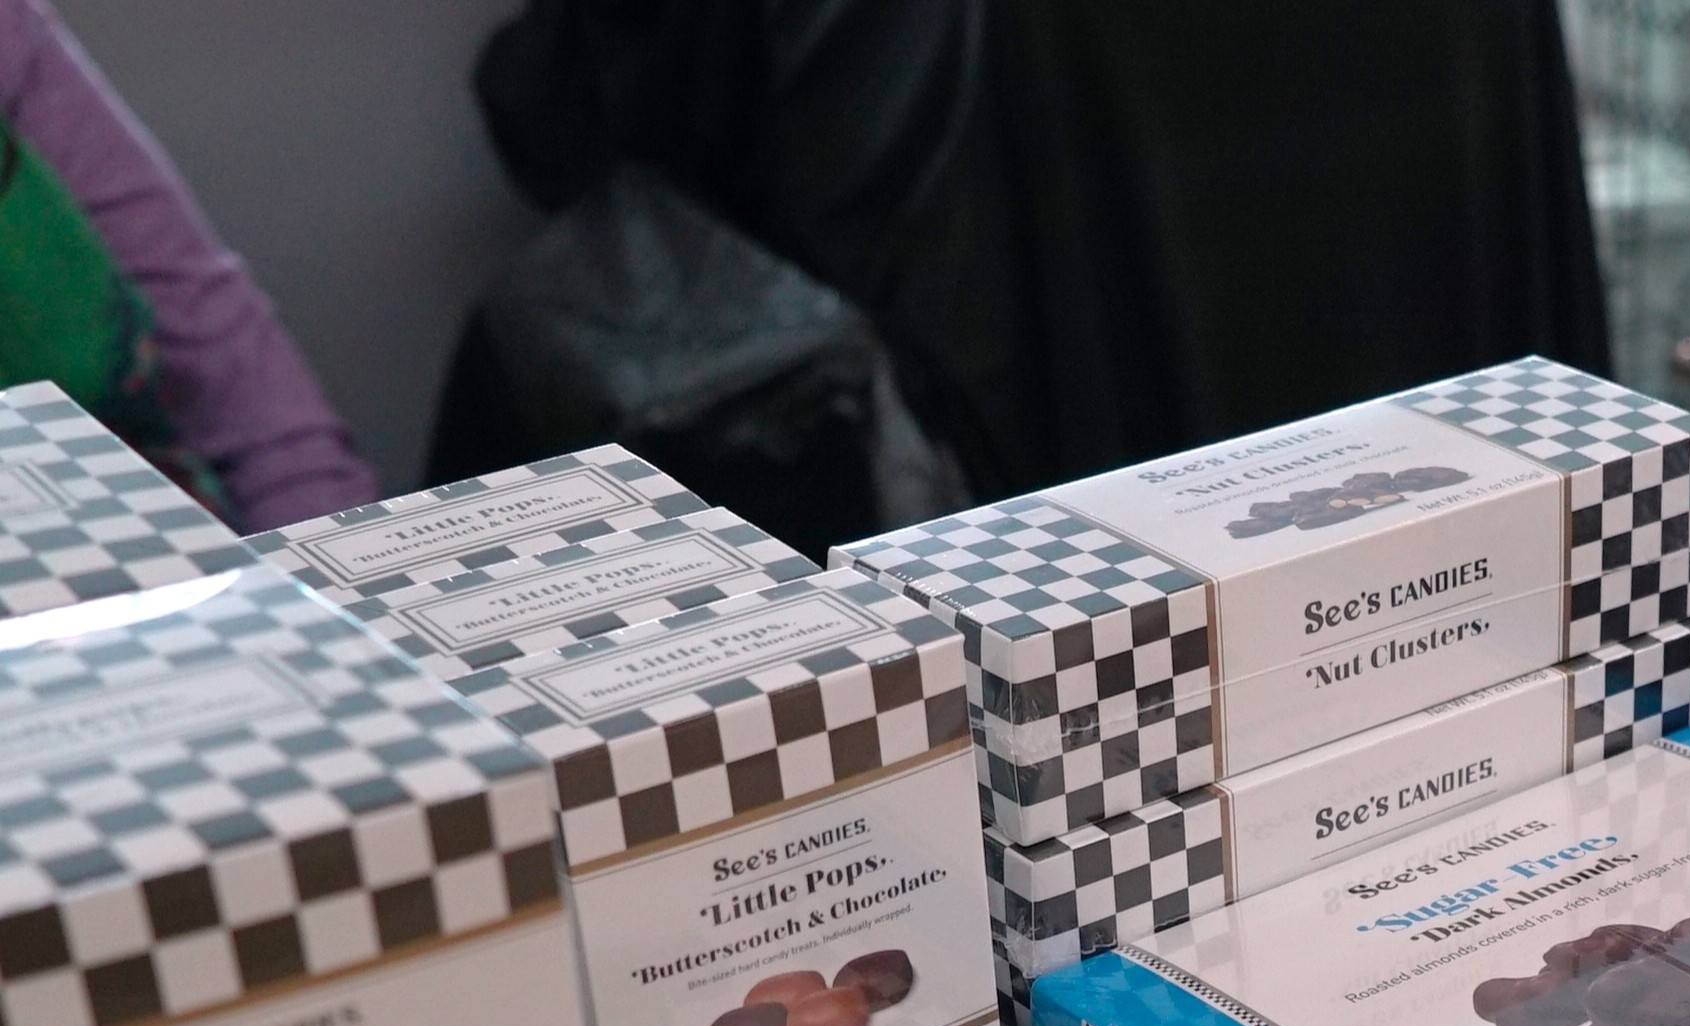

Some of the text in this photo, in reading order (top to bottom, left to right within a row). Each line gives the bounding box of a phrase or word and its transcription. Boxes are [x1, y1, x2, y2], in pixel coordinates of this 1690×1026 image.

[1137, 455, 1226, 485] See's
[1302, 591, 1382, 637] See's
[1304, 652, 1364, 690] Nut
[1314, 794, 1391, 842] See's
[712, 847, 779, 883] See's
[1347, 863, 1439, 901] See's
[699, 883, 798, 927] Little
[822, 919, 874, 945] Individually
[1344, 972, 1412, 1004] Roasted
[1410, 944, 1480, 978] almonds
[1478, 919, 1537, 949] covered
[1535, 912, 1553, 925] in
[1551, 906, 1565, 917] a
[1598, 879, 1633, 898] dark
[1409, 906, 1506, 943] Dark
[630, 918, 802, 986] Butterscotch
[807, 909, 826, 929] &
